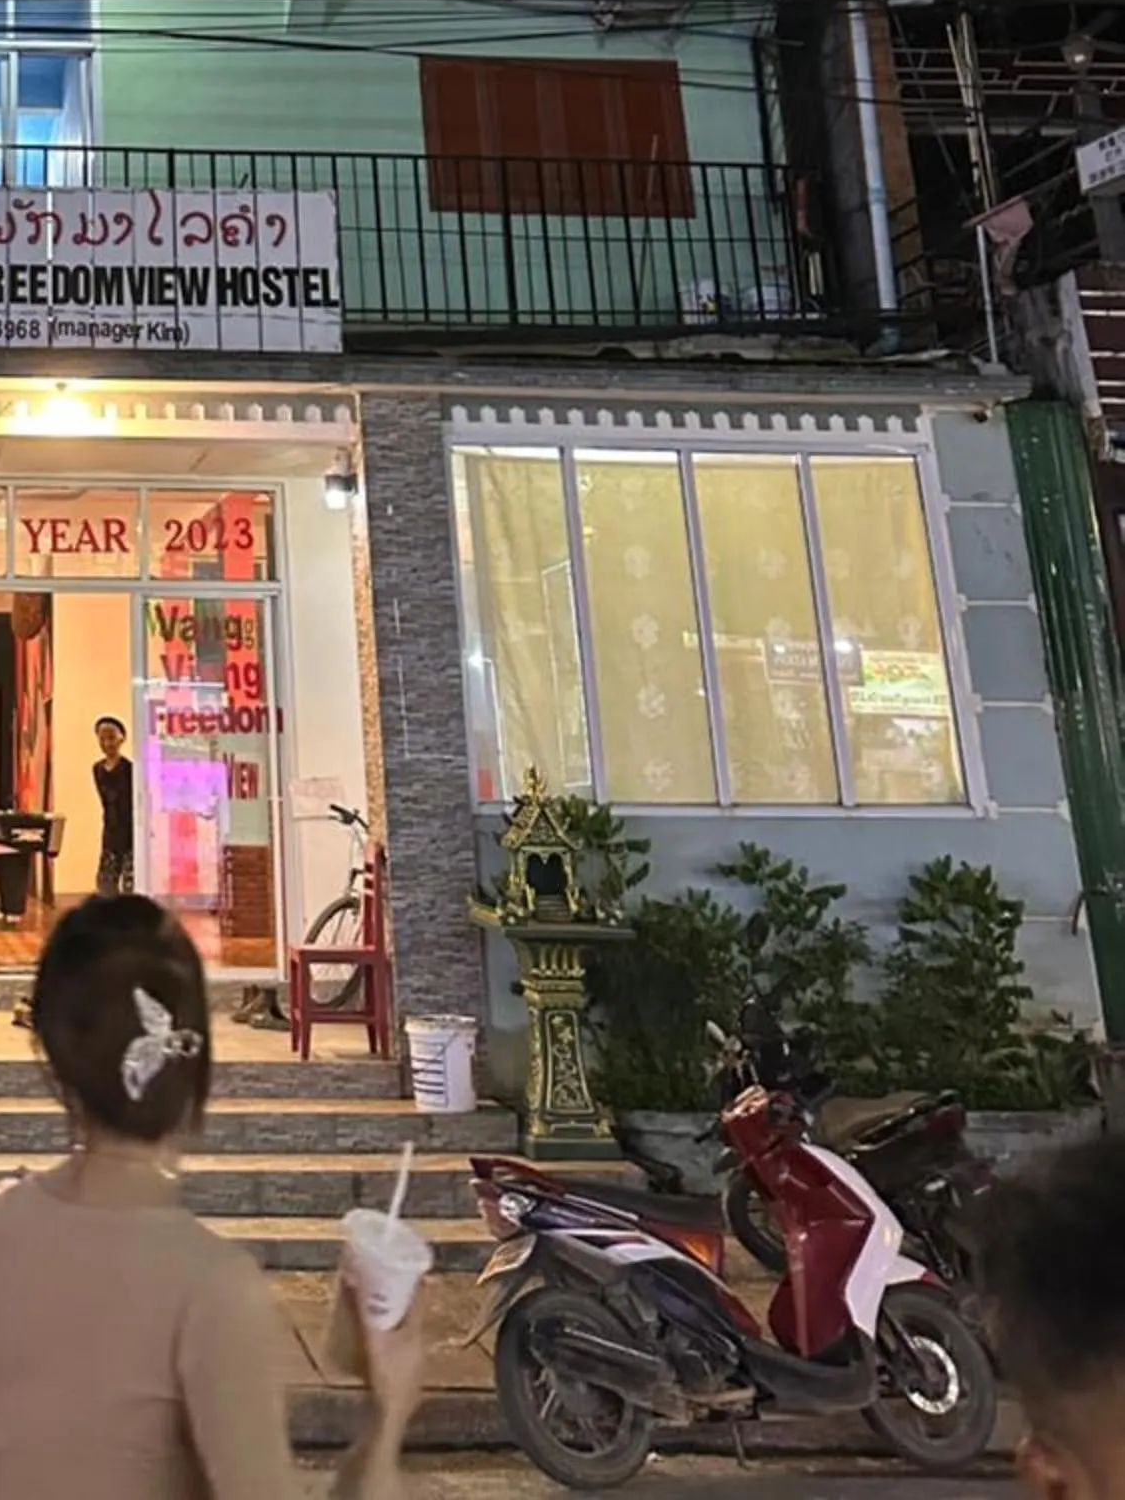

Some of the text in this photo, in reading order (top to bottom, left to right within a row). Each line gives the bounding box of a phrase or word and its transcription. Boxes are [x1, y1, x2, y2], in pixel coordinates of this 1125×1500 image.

[217, 266, 340, 308] HOSTEL
[52, 316, 143, 343] (manager
[21, 518, 129, 553] YEAR
[164, 518, 255, 552] 2023
[160, 654, 261, 699] Ving
[149, 697, 284, 735] Freedom
